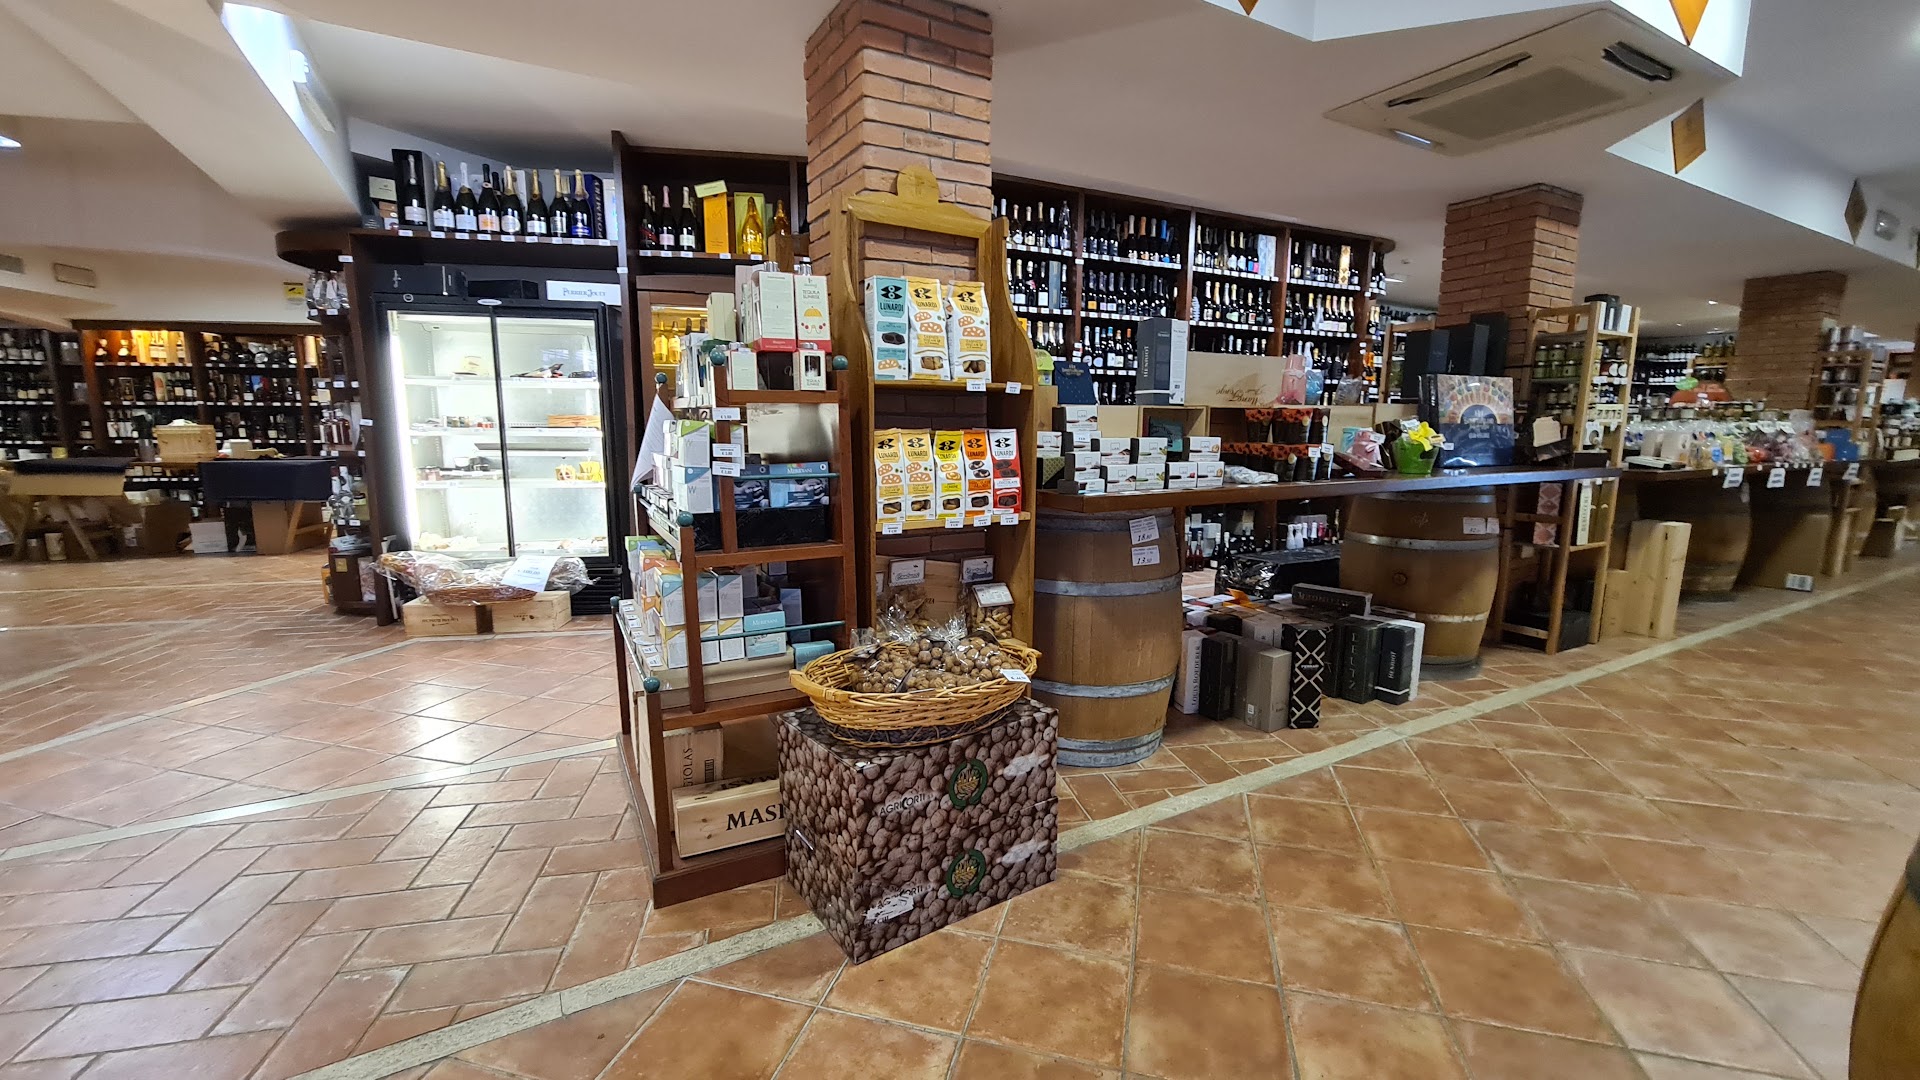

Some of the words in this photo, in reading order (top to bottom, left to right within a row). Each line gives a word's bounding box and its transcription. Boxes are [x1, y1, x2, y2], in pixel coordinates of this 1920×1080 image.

[594, 180, 603, 239] POMMERY
[880, 302, 904, 312] LUNARDI
[916, 300, 938, 308] LUNARDI
[960, 304, 981, 313] LUNARDI
[878, 451, 899, 459] LUNARDI
[1191, 681, 1199, 706] LOUIS
[880, 793, 925, 816] AGRICORTI
[726, 803, 785, 831] MASI
